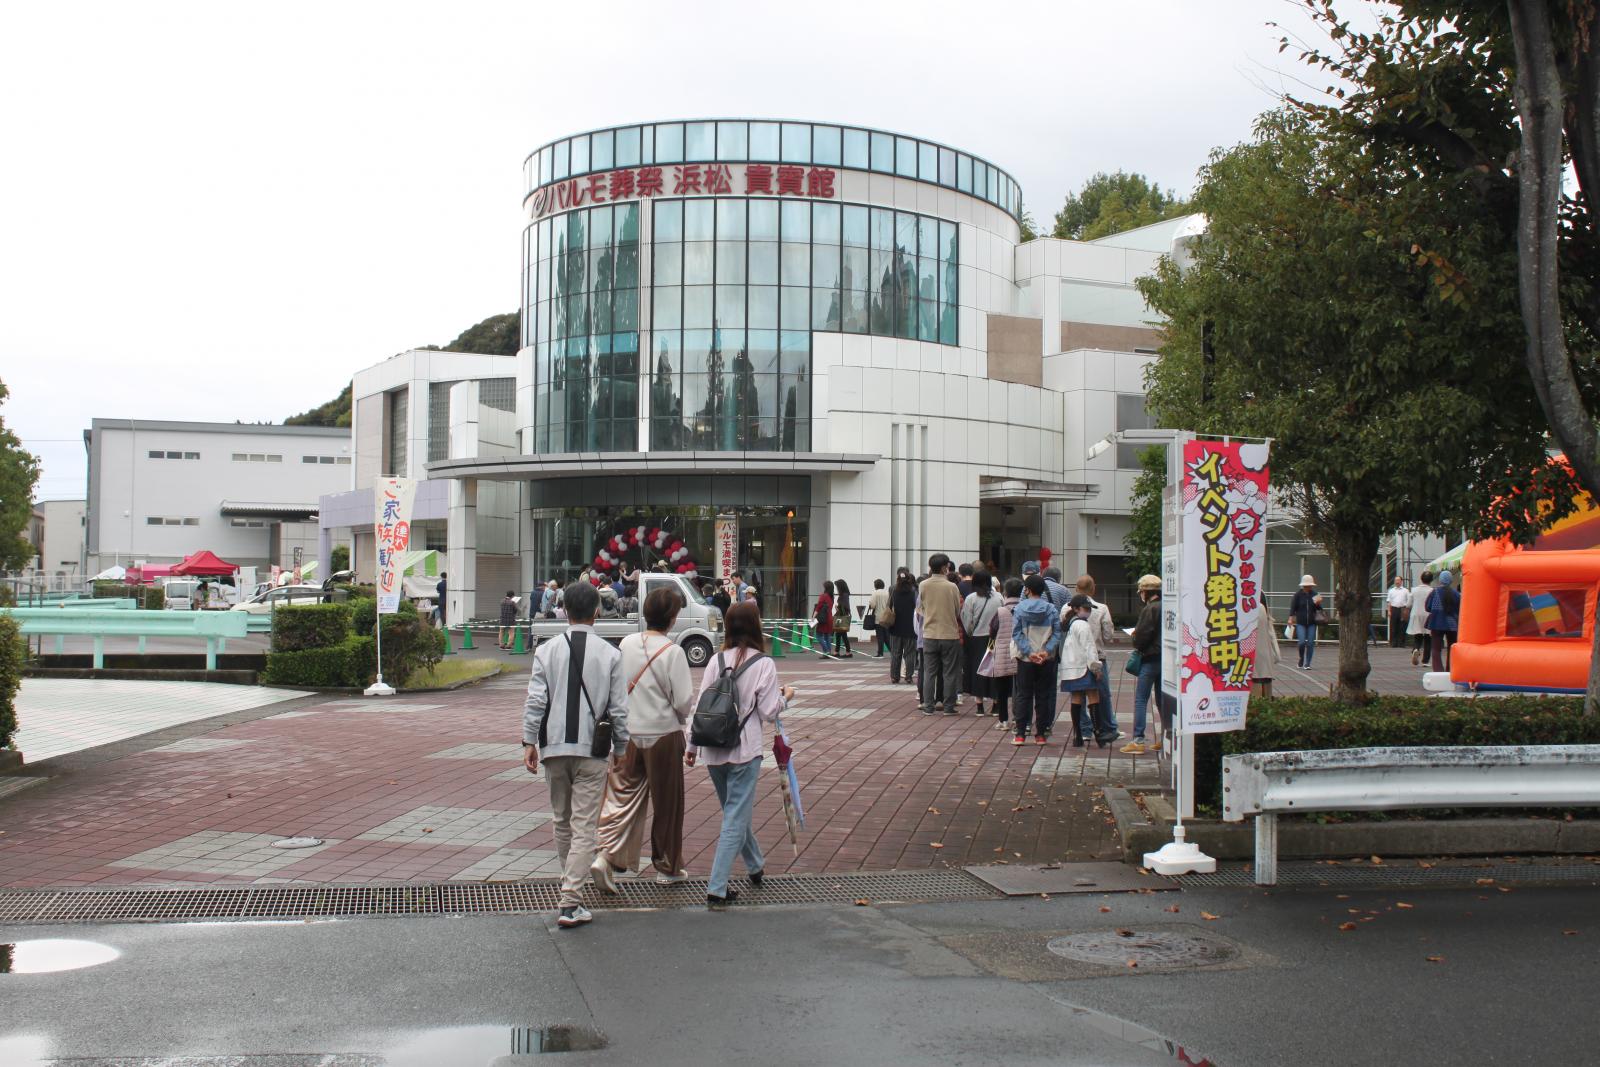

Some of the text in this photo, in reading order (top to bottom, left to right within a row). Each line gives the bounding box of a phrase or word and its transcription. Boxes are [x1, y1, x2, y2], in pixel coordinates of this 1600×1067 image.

[673, 164, 732, 195] 浜松
[744, 164, 836, 199] 貴賓館
